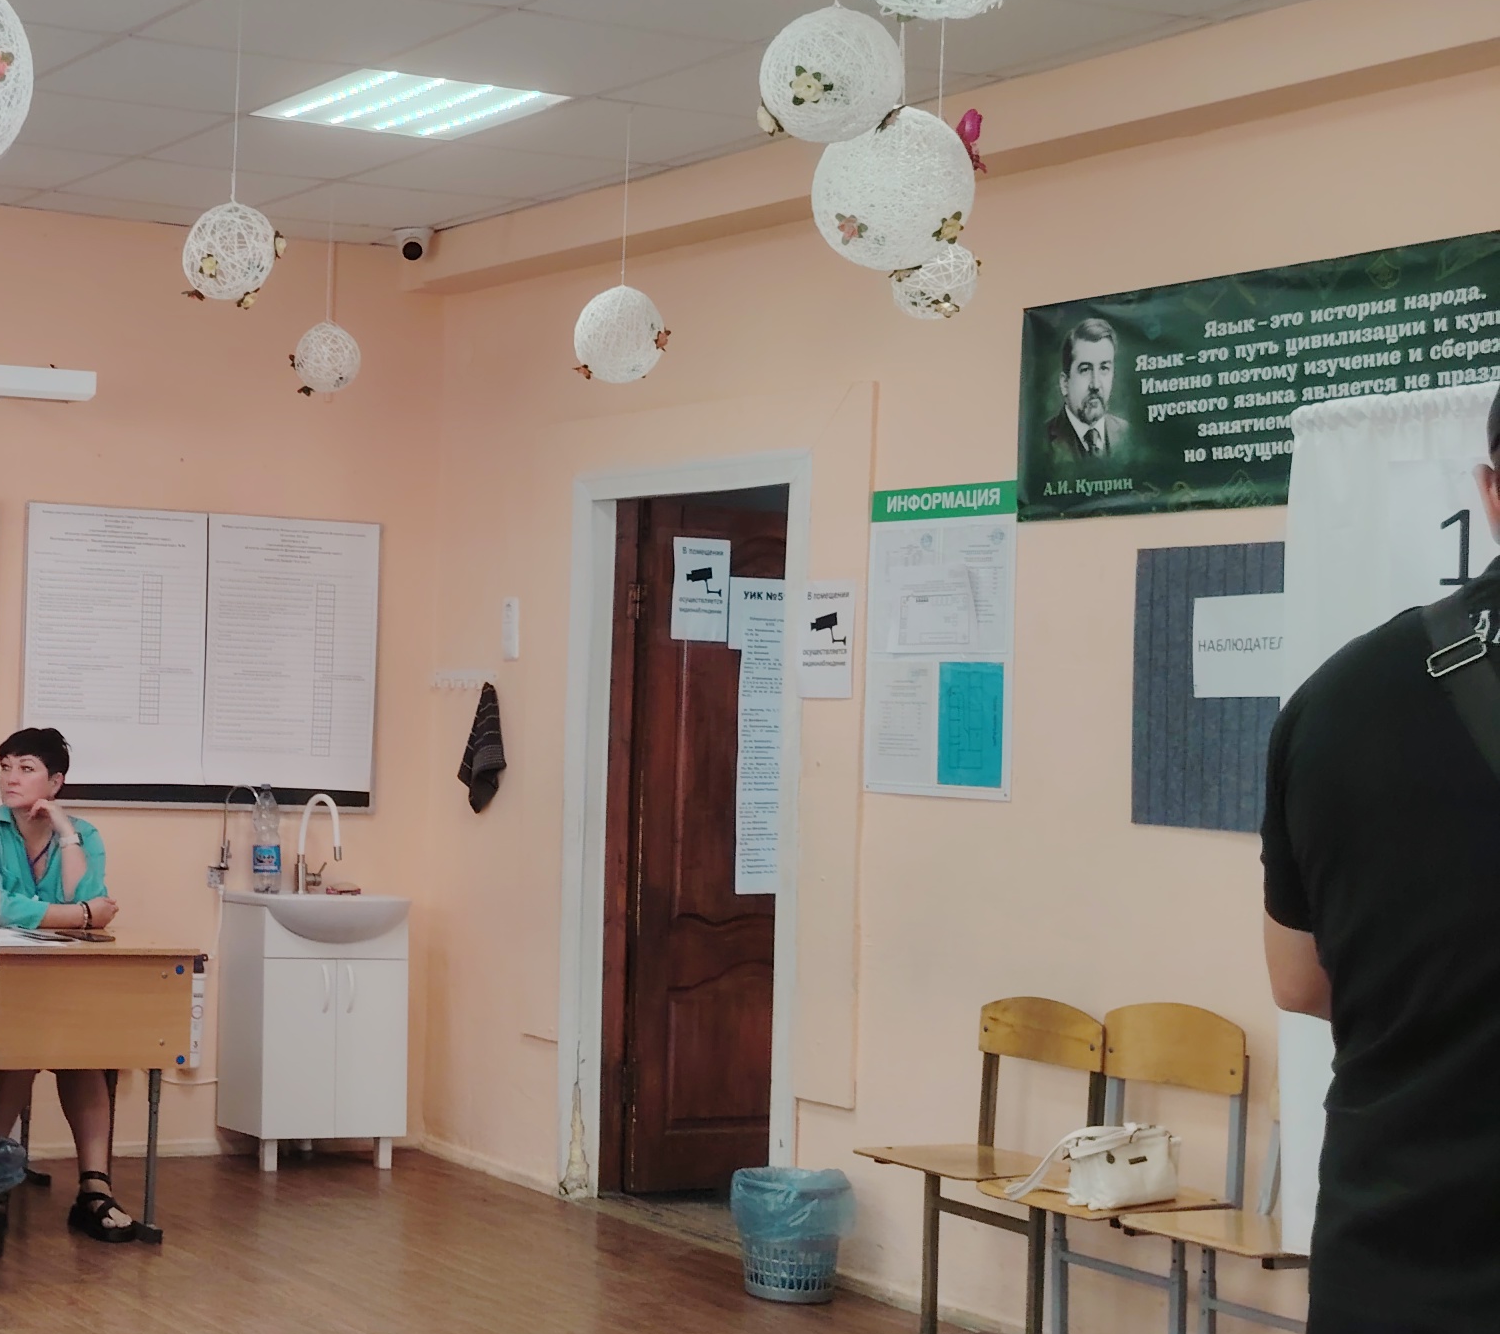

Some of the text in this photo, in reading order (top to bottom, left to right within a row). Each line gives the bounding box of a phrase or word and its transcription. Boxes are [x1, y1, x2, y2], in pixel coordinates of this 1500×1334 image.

[1311, 297, 1397, 323] история
[1404, 286, 1487, 311] народа.
[1235, 341, 1279, 362] путь
[1285, 320, 1426, 358] цивилизации
[1433, 318, 1448, 332] и
[1141, 374, 1212, 394] Именно
[1218, 363, 1298, 382] поэтому
[1304, 350, 1402, 378] изучение
[1408, 347, 1424, 362] и
[1148, 397, 1228, 422] русского
[1234, 389, 1297, 408] языка
[1301, 376, 1397, 401] является
[1404, 373, 1430, 389] не
[1198, 415, 1292, 437] занятием
[1184, 447, 1206, 463] но
[1043, 477, 1133, 496] А.И. Куприн
[887, 488, 1000, 513] ИНФОРМАЦИЯ
[744, 591, 784, 601] УИК №5
